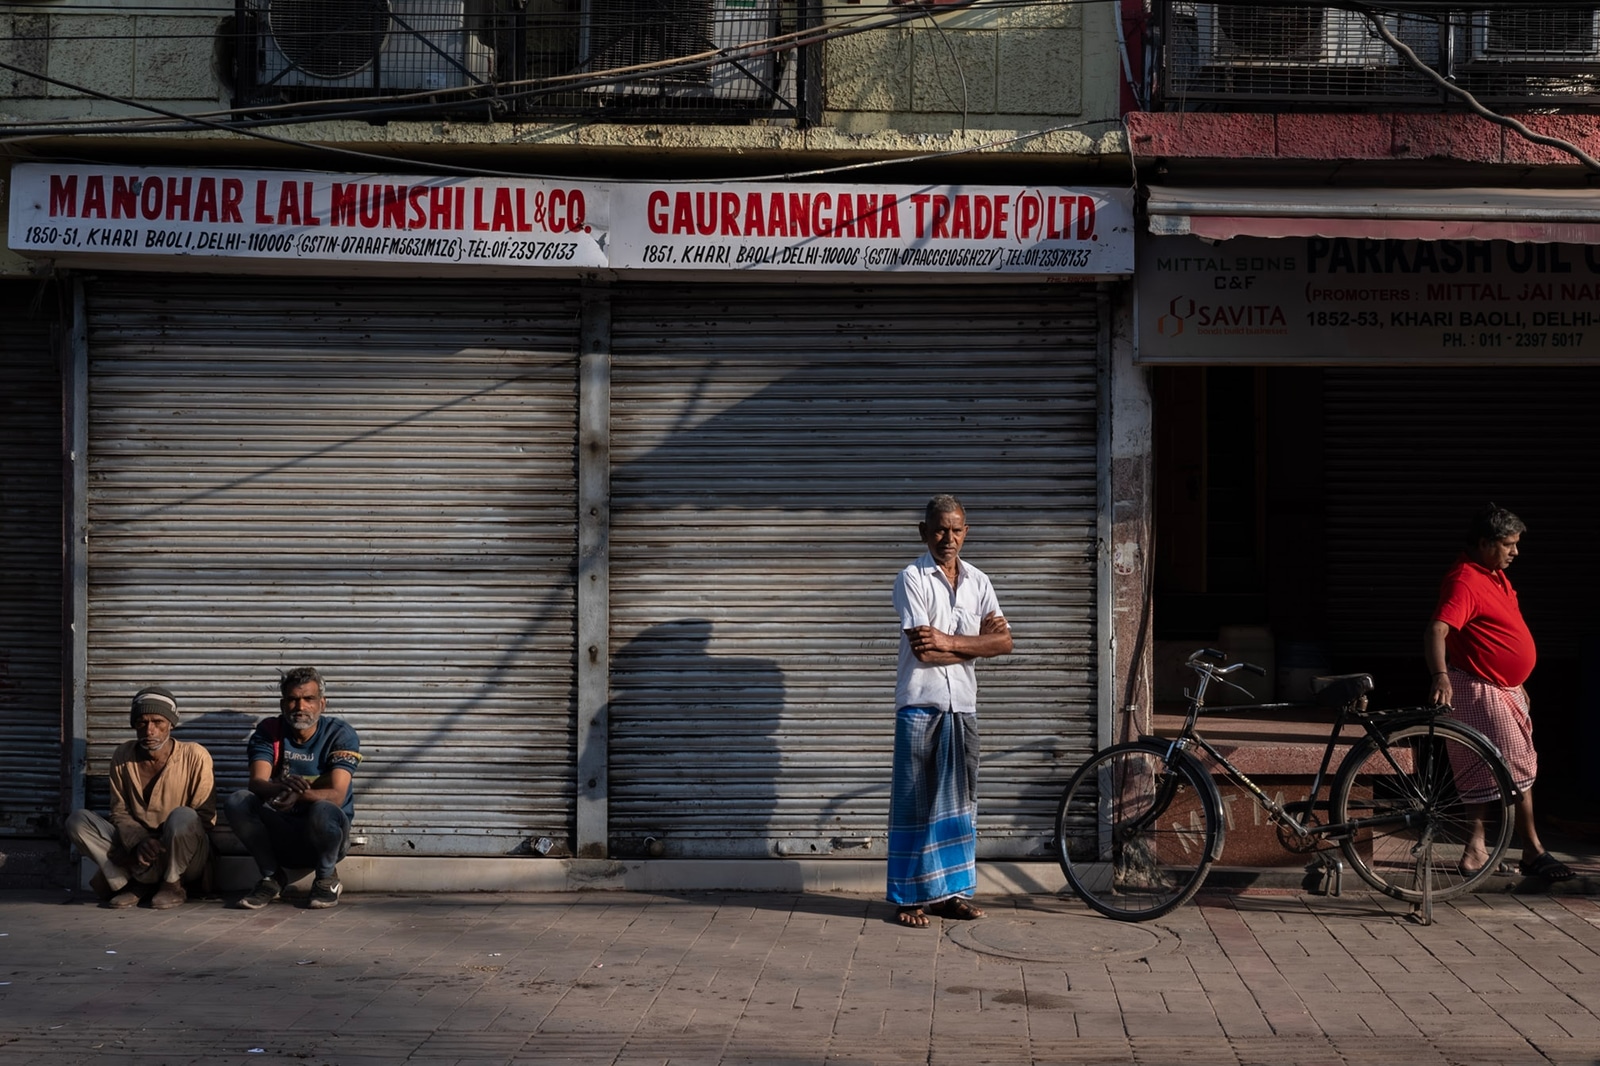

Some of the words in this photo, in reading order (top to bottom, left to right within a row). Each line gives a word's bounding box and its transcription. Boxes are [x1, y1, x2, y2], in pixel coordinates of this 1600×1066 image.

[49, 175, 244, 224] MANOHAR
[255, 179, 320, 226] LAL
[330, 182, 465, 230] MUNSHI
[647, 190, 901, 239] GAURAANGANA
[910, 194, 1010, 240] TRADE
[25, 227, 82, 248] 1850-51,
[86, 228, 139, 248] KHARI
[681, 245, 731, 264] KHARI
[1307, 238, 1492, 274] PARKASH
[1506, 242, 1572, 274] OIL
[1214, 276, 1256, 290] C&F
[1427, 283, 1510, 301] MITTAL
[1561, 283, 1600, 301] NA
[1198, 306, 1287, 326] SAVITA
[1307, 311, 1384, 329] 1852-53,
[1391, 311, 1453, 326] KHARI
[1460, 311, 1526, 329] BAOLI,
[1480, 333, 1501, 347] 011
[1515, 333, 1548, 347] 2397
[1551, 333, 1583, 347] 5017
